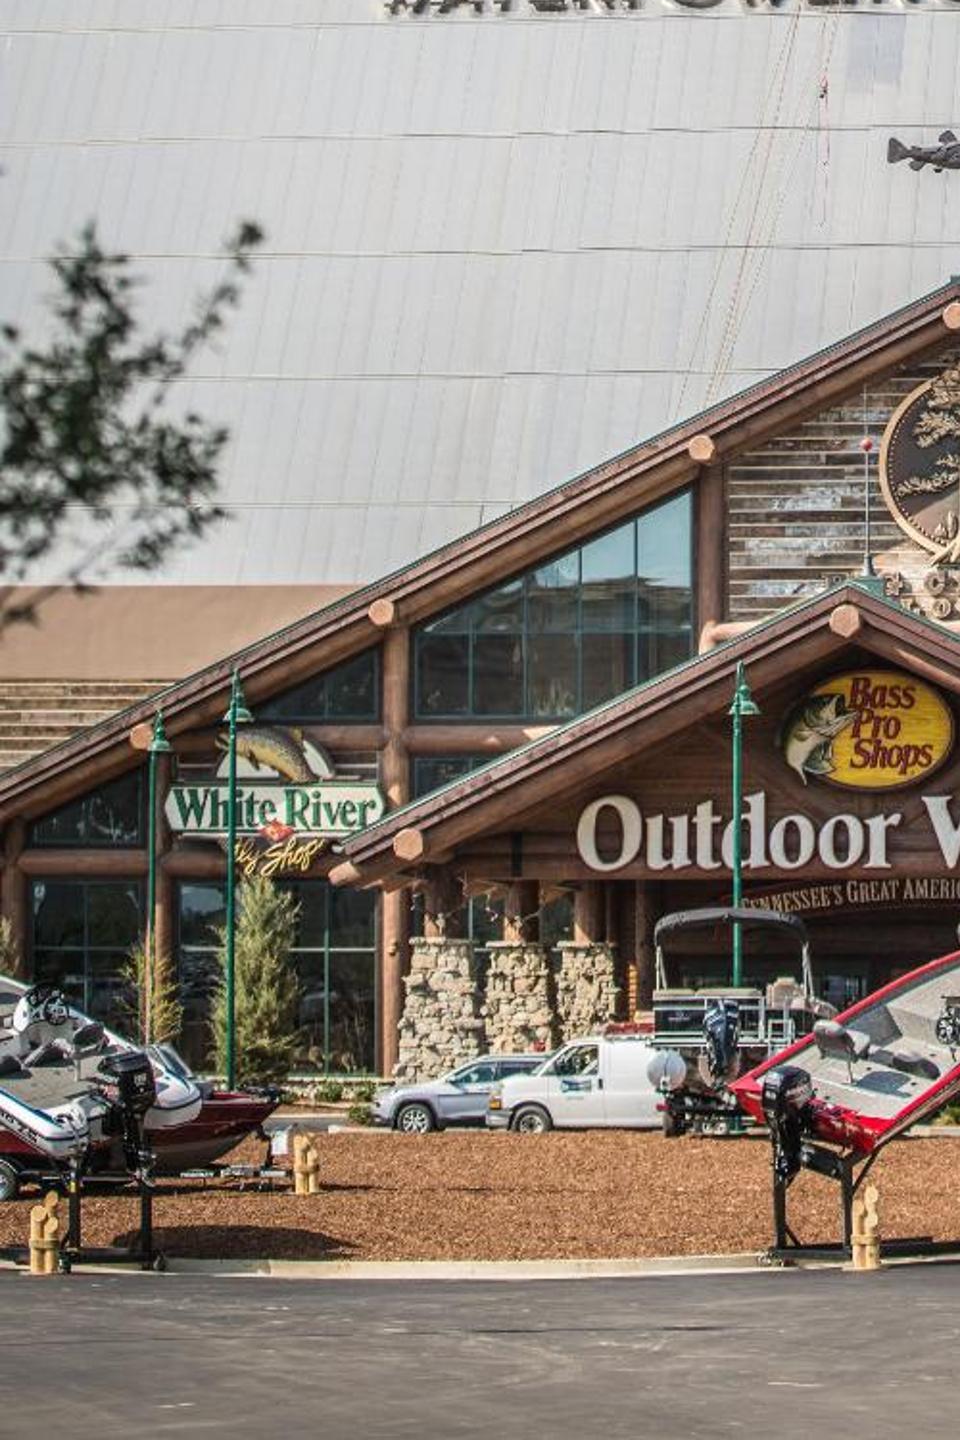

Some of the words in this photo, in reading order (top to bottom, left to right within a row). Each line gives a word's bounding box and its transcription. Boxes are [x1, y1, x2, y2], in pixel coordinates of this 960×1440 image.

[847, 676, 918, 710] Bass
[850, 707, 902, 740] Pro
[849, 738, 934, 775] Shops
[171, 788, 278, 830] White
[283, 788, 377, 831] River
[575, 790, 904, 872] Outdoor
[260, 837, 326, 877] Shop
[845, 879, 900, 904] GREAT
